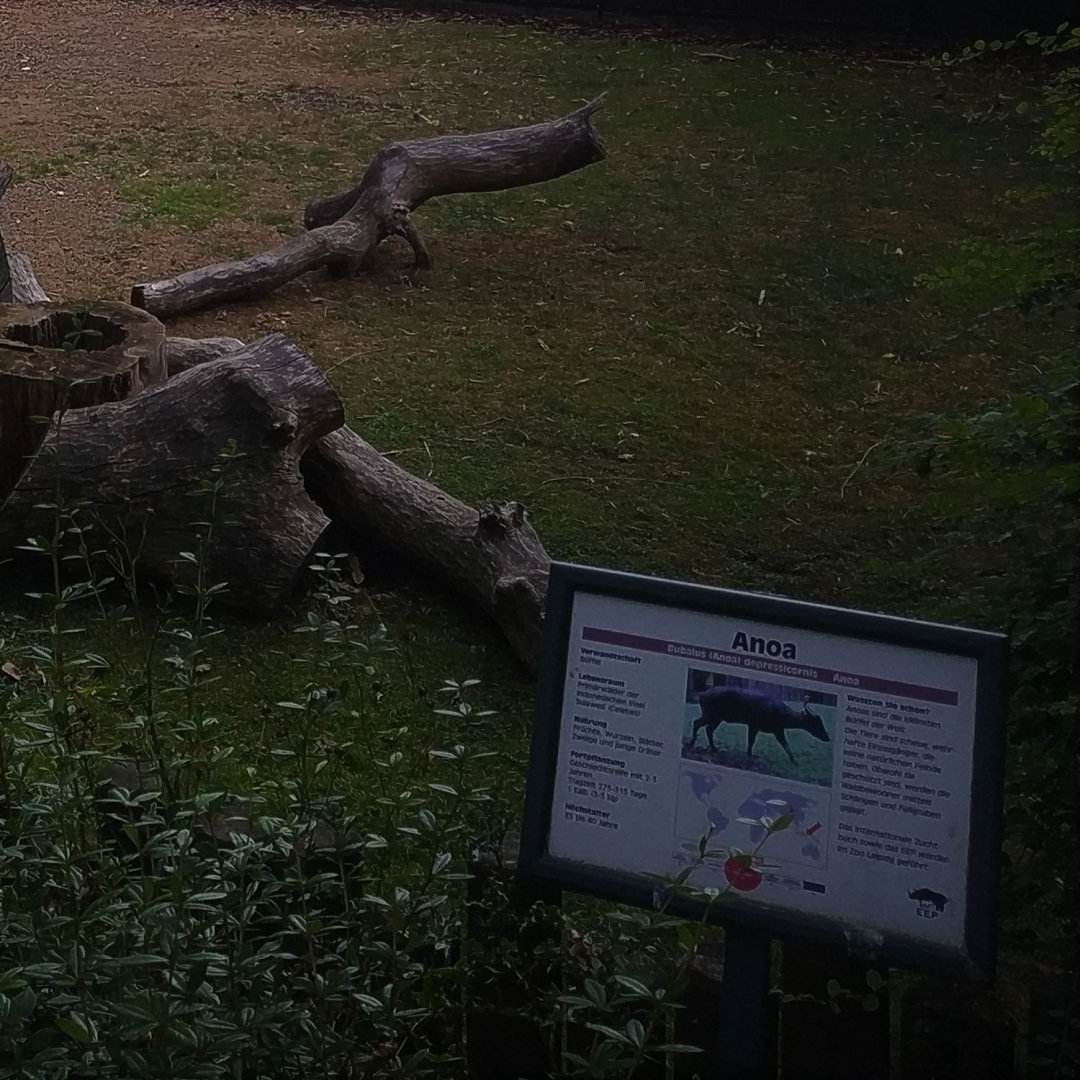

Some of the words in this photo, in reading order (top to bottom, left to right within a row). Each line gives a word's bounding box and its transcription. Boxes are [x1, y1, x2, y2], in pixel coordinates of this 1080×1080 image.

[732, 631, 796, 660] Anoa
[581, 648, 641, 664] Verwandtschaft
[667, 644, 706, 659] Bubalus
[709, 651, 741, 664] (Anoa)
[744, 658, 818, 678] depressicornis
[579, 673, 624, 687] Lebensraum
[833, 673, 859, 686] Anoa
[846, 706, 869, 715] Anoas
[872, 711, 888, 719] sind
[886, 701, 898, 710] Sie
[901, 705, 929, 715] schon?
[574, 716, 607, 728] Nahrung
[572, 733, 597, 744] Zweige
[599, 739, 613, 747] und
[615, 741, 636, 751] junge
[860, 730, 879, 739] Tiere
[881, 734, 898, 742] sind
[571, 751, 625, 768] Fortpflanzung
[844, 749, 865, 758] keine
[569, 760, 628, 777] Geschlechtsreife
[630, 772, 643, 780] mit
[872, 766, 902, 777] Obwohl
[574, 787, 588, 795] Kalb
[905, 784, 935, 795] werden
[938, 790, 951, 798] die
[566, 803, 610, 818] Höchstalter
[881, 801, 896, 809] und
[575, 814, 585, 822] bis
[599, 819, 618, 829] Jahre
[839, 823, 853, 831] Das
[838, 835, 858, 843] buch
[860, 839, 883, 848] sowie
[885, 844, 898, 852] das
[919, 851, 950, 863] werden
[850, 848, 864, 857] Zoo
[867, 851, 895, 864] Leipzig
[916, 908, 938, 919] EEP
